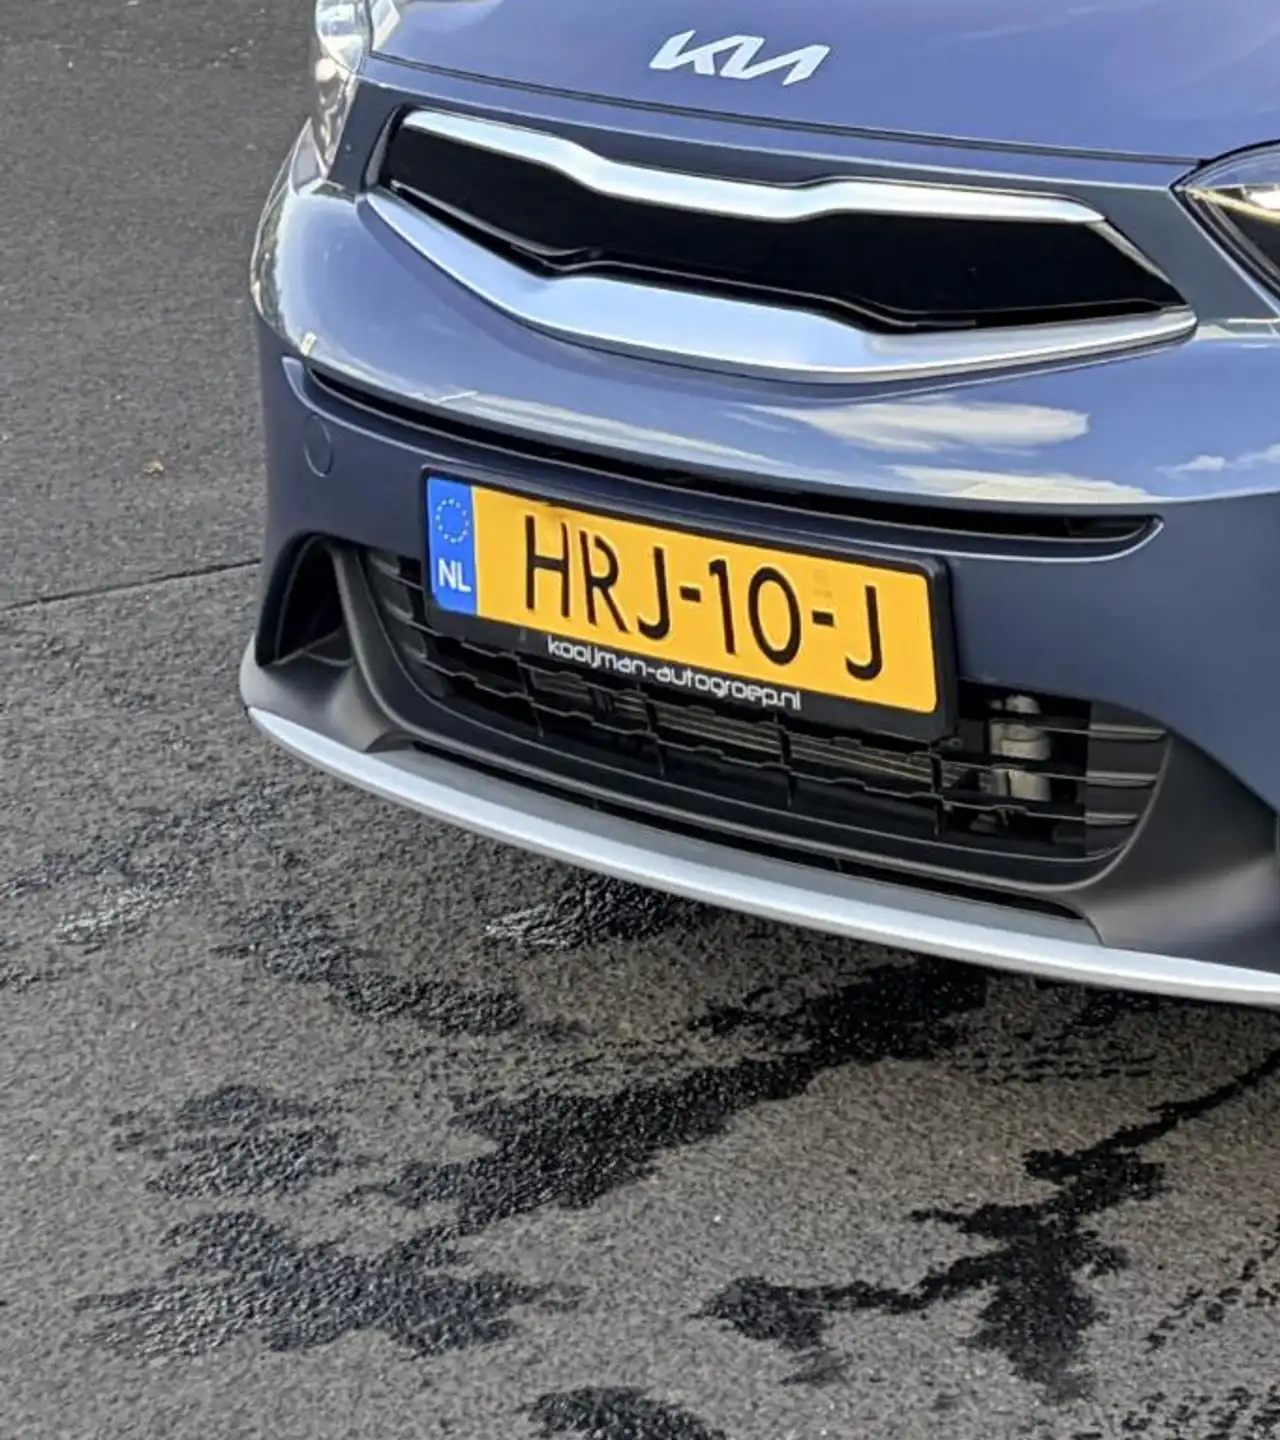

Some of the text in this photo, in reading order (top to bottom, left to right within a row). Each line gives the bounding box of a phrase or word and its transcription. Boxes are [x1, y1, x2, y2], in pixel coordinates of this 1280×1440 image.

[648, 29, 831, 86] KIA
[438, 559, 472, 594] NL
[524, 515, 884, 681] HRJ-10-J
[546, 634, 802, 711] kooijman-autogroep.nl
